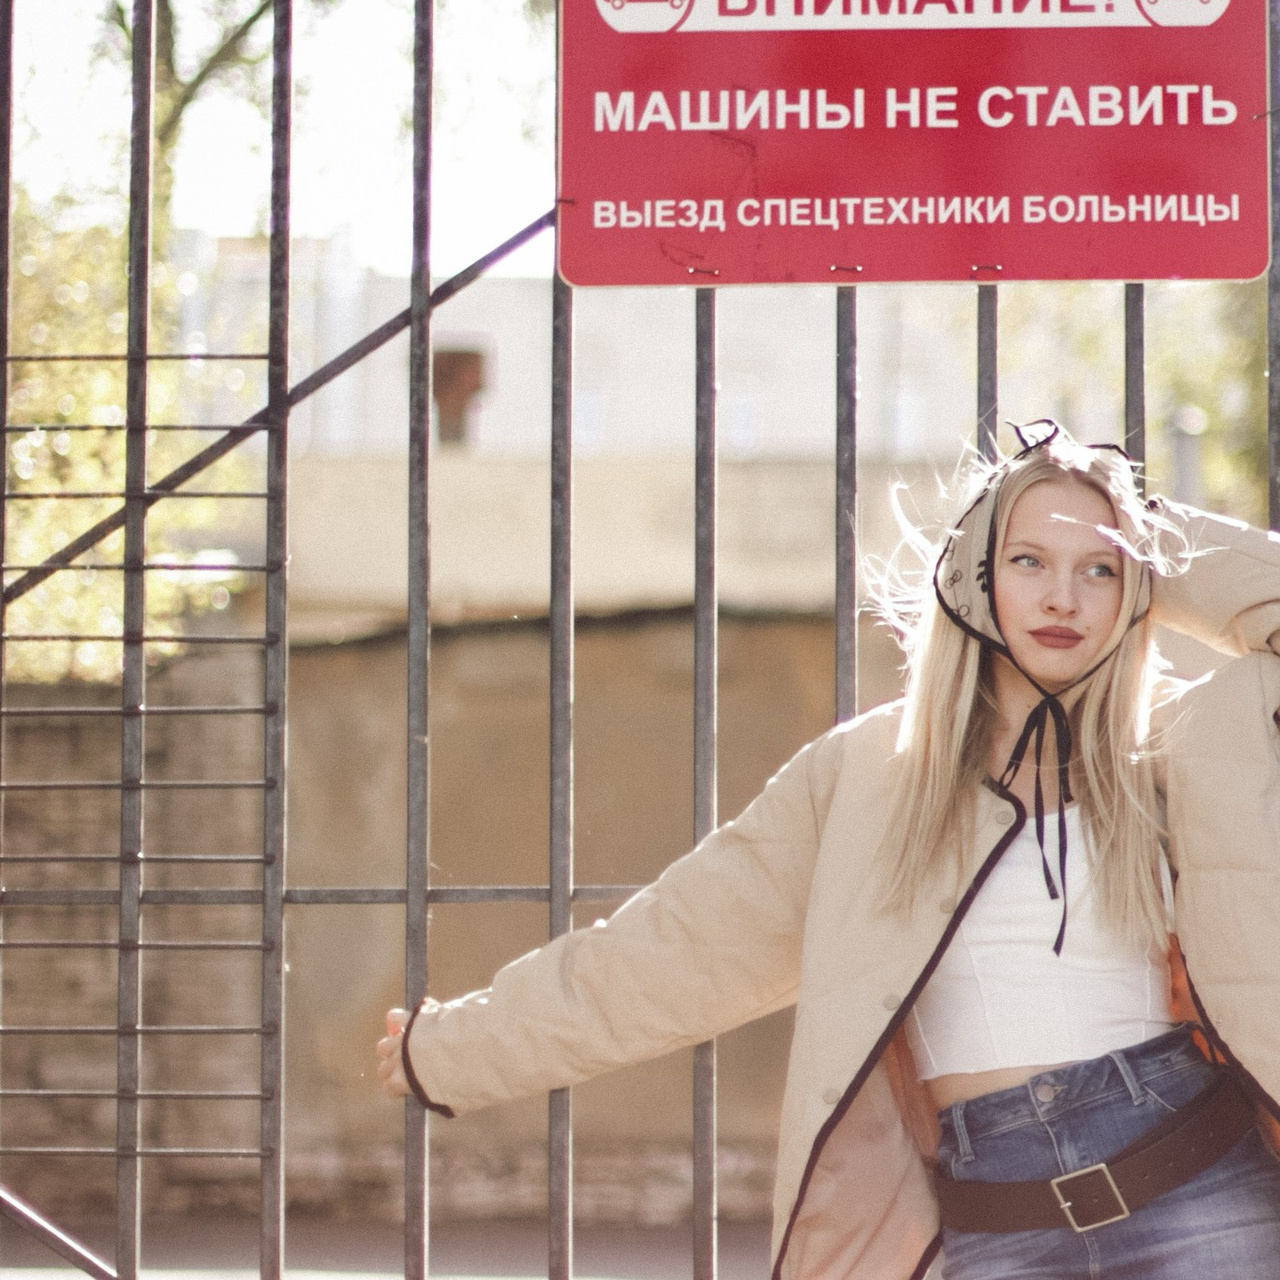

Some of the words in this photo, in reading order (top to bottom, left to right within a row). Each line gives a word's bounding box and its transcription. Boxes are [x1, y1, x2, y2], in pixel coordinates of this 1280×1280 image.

[594, 88, 865, 132] МАШИНЫ
[885, 86, 960, 129] НЕ
[977, 84, 1238, 128] СТАВИТЬ
[594, 198, 726, 232] ВЫЕЗД
[736, 196, 1011, 230] СПЕЦТЕХНИКИ
[1022, 194, 1240, 226] БОЛЬНИЦЫ
